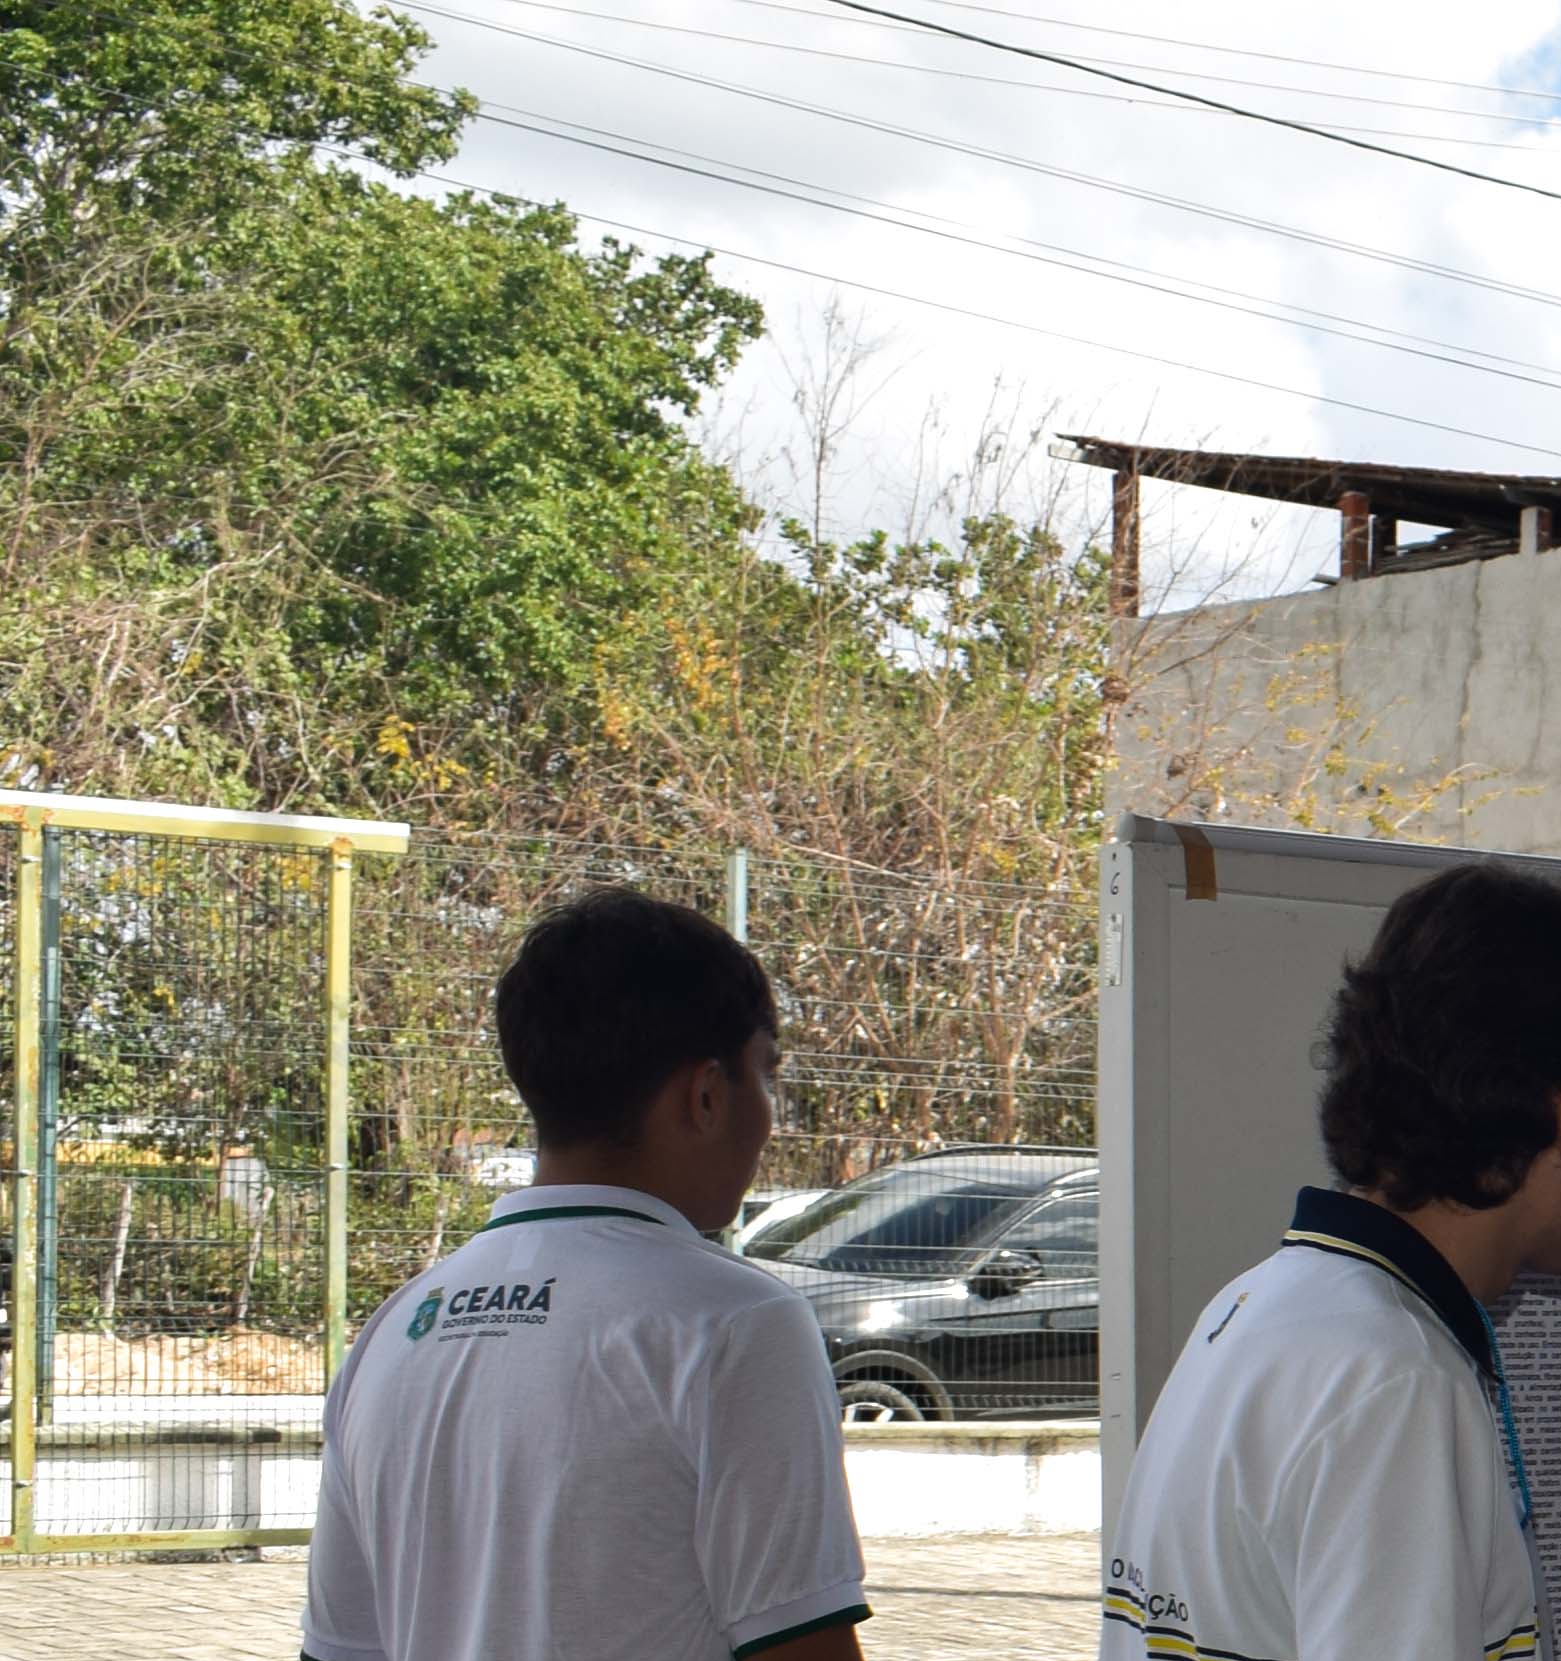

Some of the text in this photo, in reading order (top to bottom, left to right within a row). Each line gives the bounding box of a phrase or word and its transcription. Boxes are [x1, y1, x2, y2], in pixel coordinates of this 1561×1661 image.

[448, 1277, 557, 1316] CEARÁ
[442, 1313, 548, 1329] GOVERNO DO ESTADO
